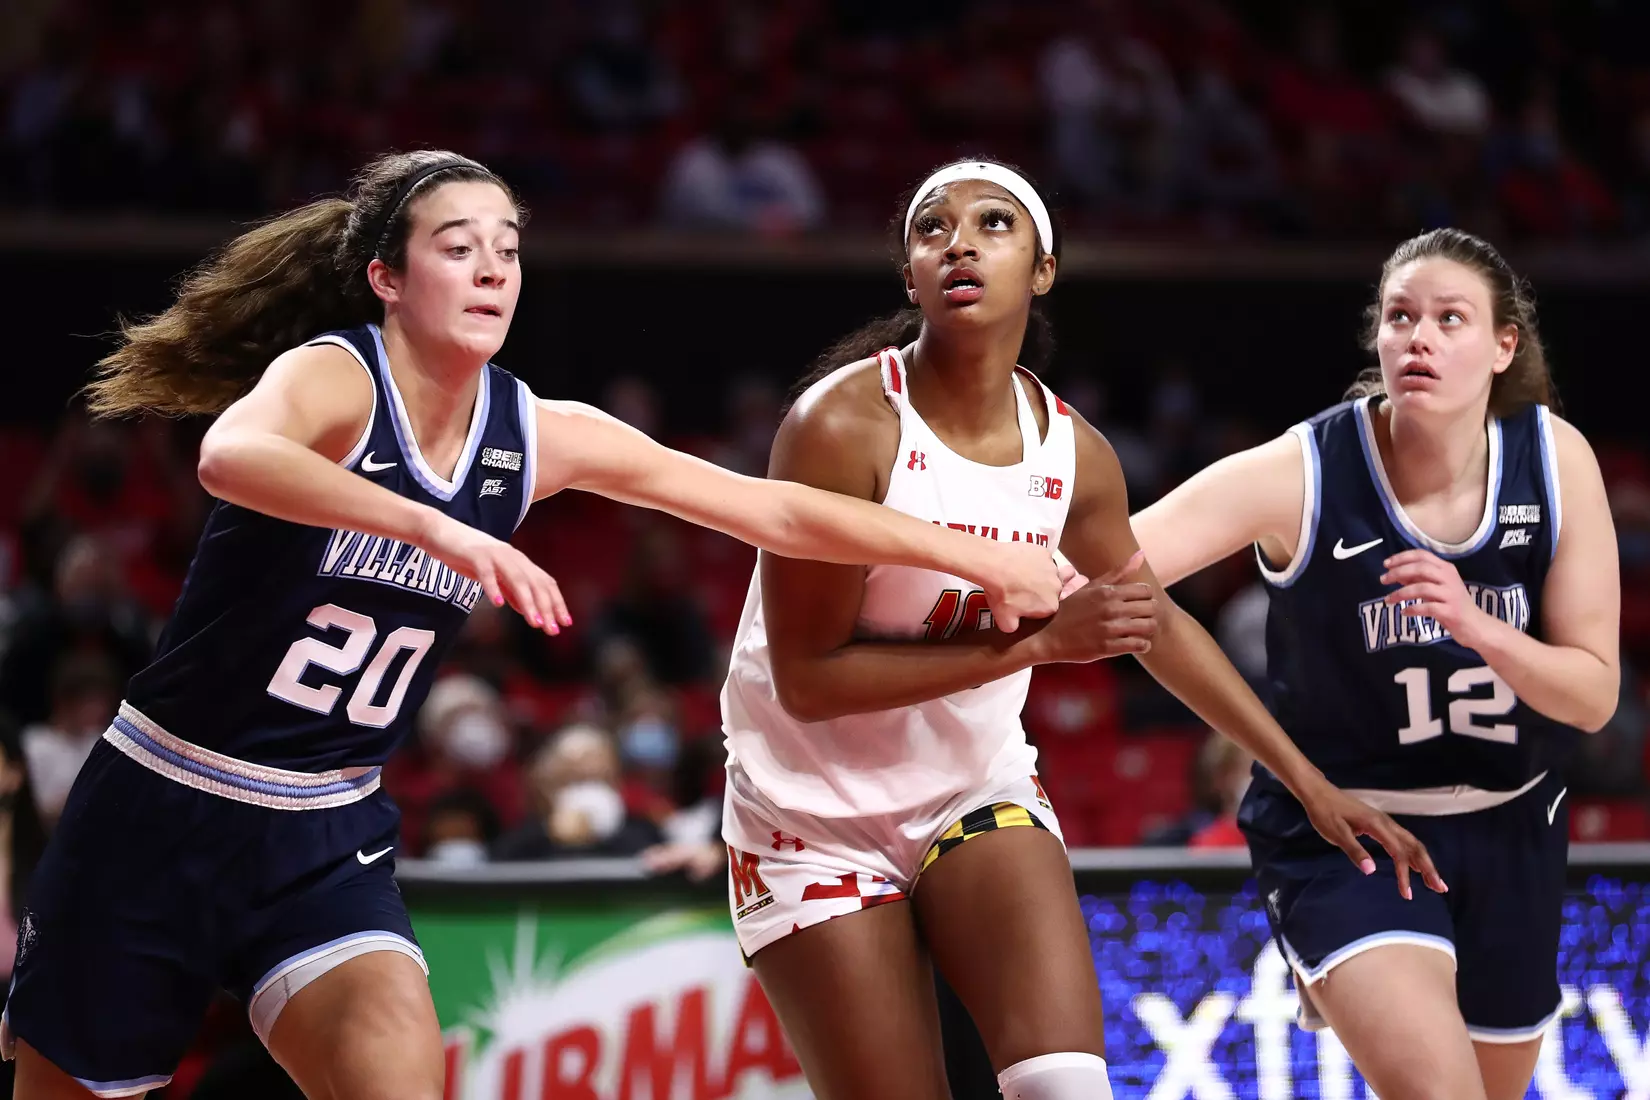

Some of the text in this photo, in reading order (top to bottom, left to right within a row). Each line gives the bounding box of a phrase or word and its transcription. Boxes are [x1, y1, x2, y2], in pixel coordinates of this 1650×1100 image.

[480, 486, 507, 494] EAST
[481, 457, 521, 471] CHANGE
[483, 478, 503, 487] BIG
[1359, 582, 1531, 653] VILLOVA
[266, 603, 436, 728] 20
[1394, 665, 1519, 745] 12
[728, 844, 771, 910] M
